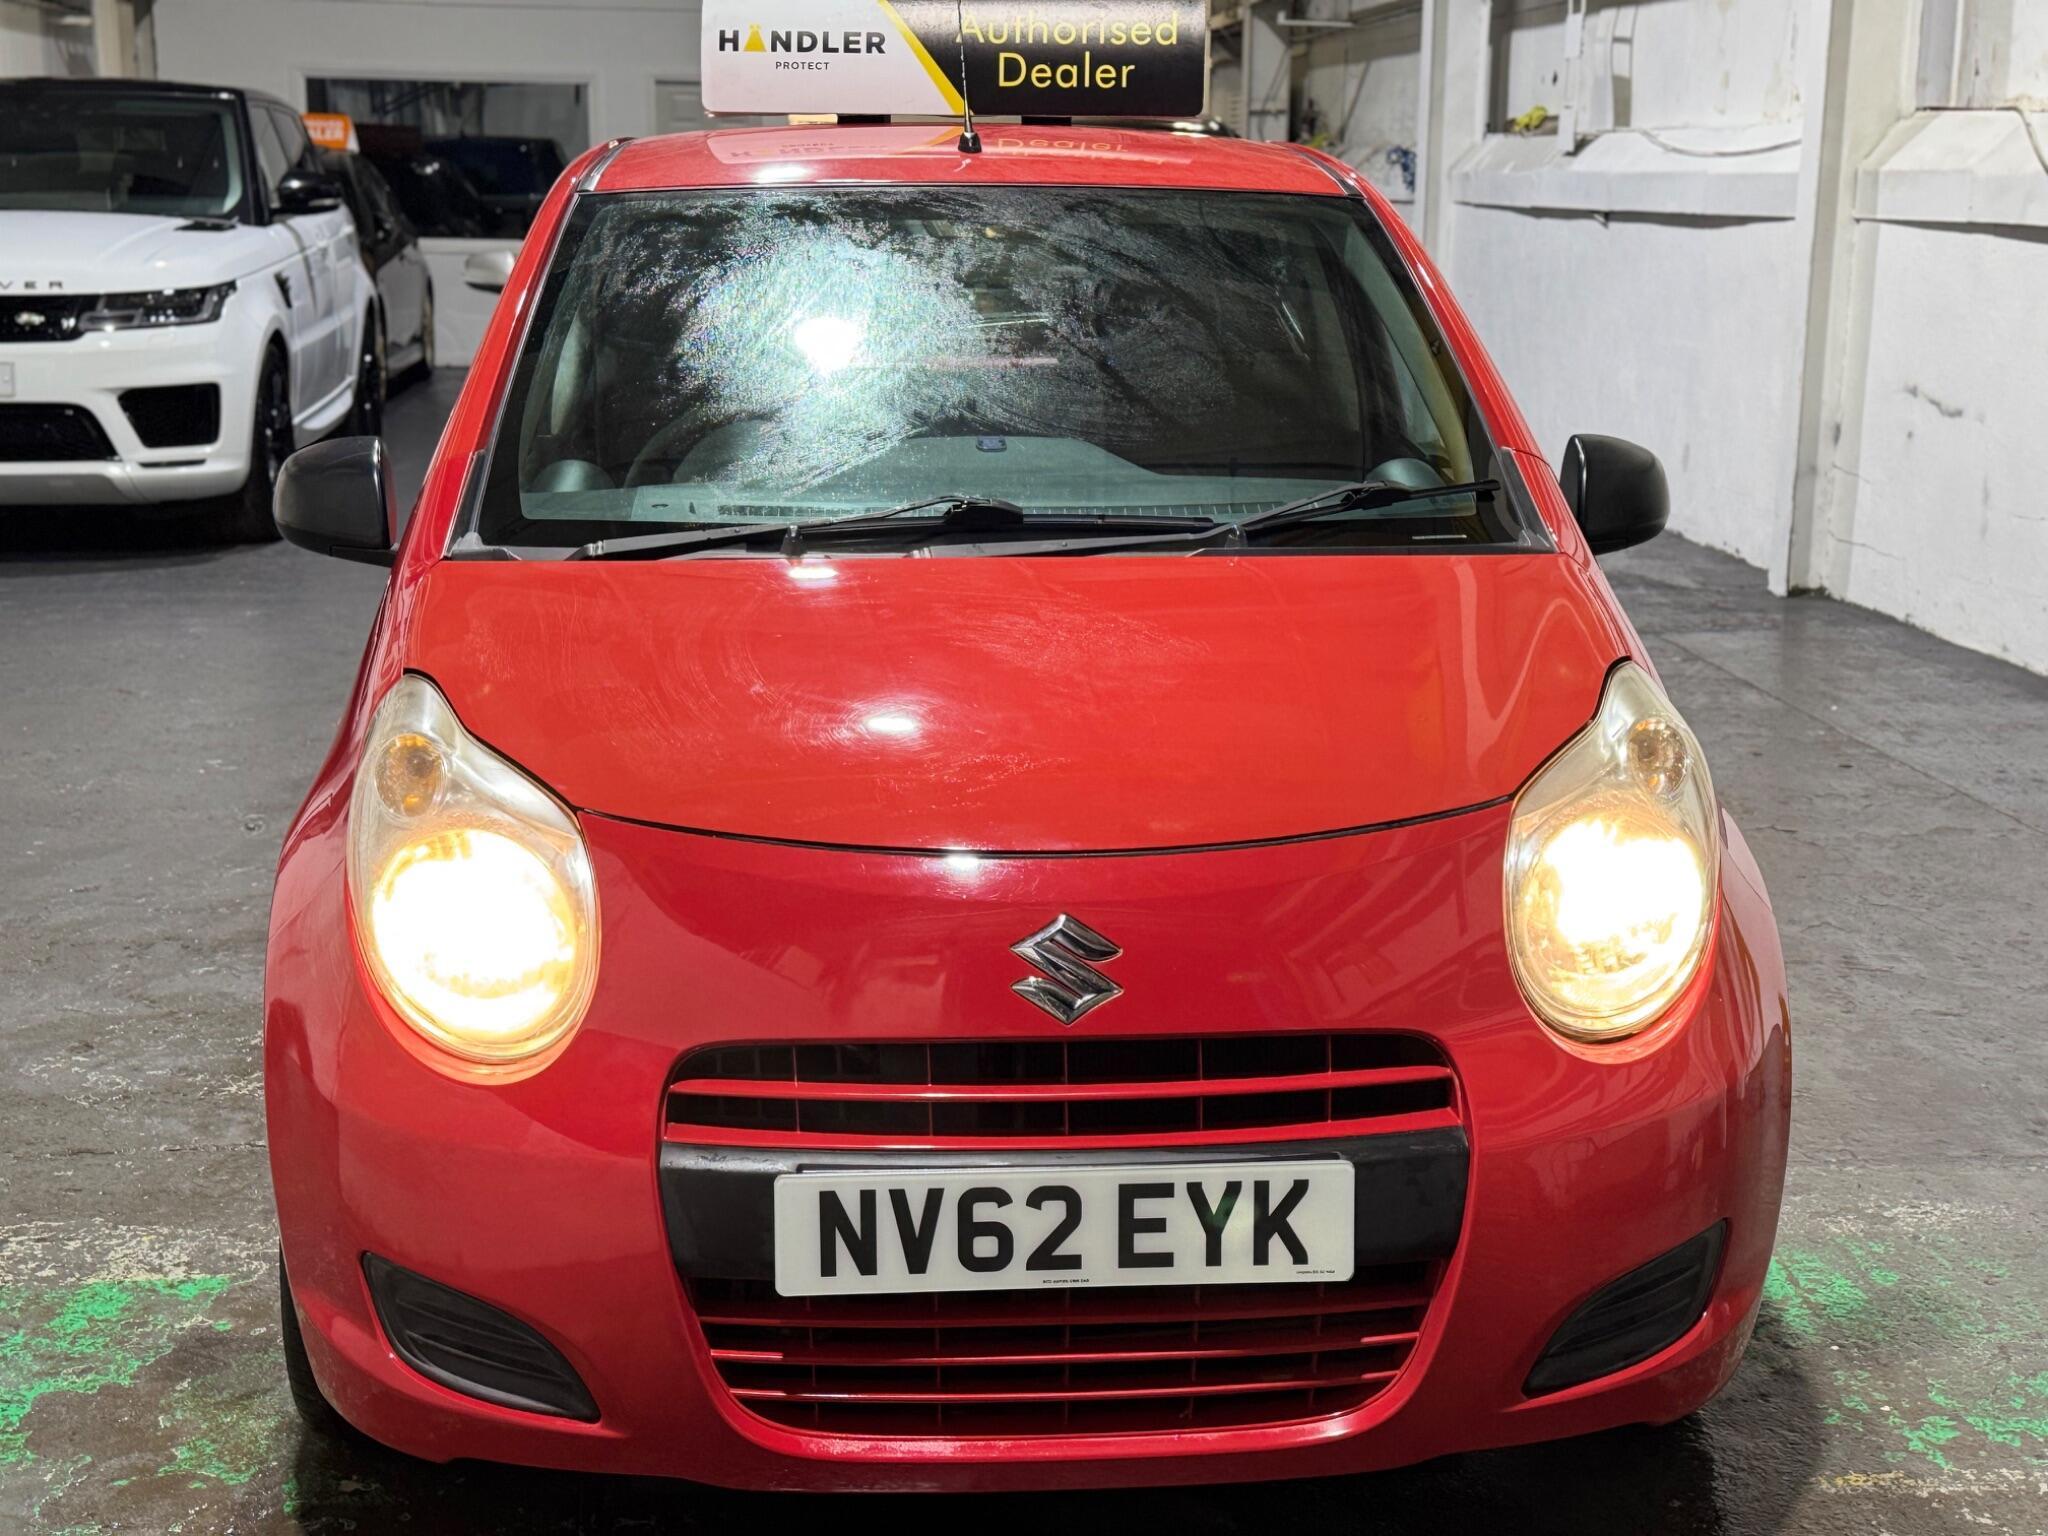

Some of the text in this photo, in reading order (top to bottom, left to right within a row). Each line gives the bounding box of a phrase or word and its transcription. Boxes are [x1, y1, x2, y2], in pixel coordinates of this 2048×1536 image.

[956, 10, 1179, 46] Authorised
[775, 61, 830, 71] PROTECT
[999, 51, 1136, 88] Dealer
[819, 1178, 1311, 1277] NV62 EYK
